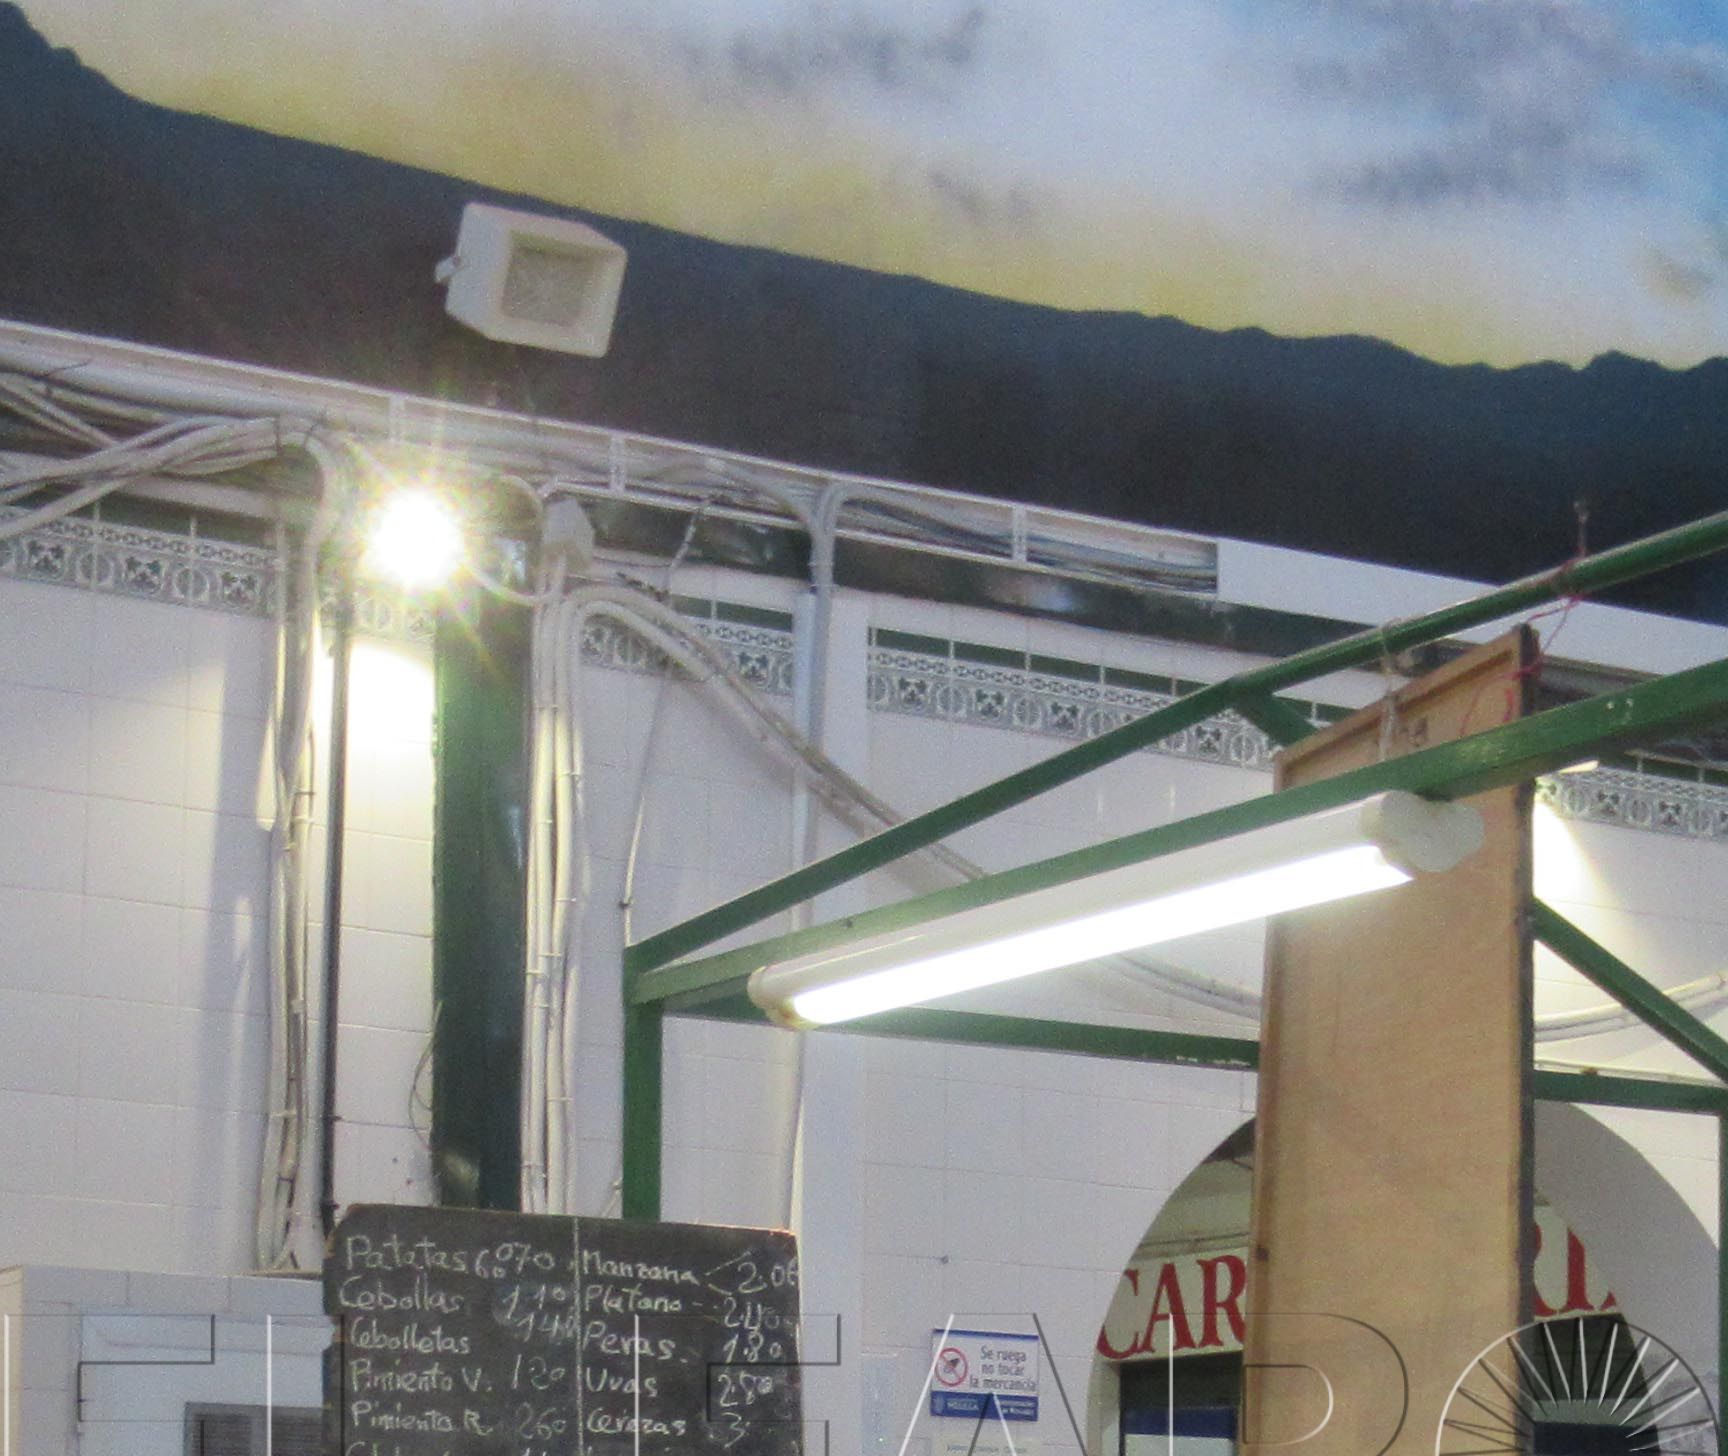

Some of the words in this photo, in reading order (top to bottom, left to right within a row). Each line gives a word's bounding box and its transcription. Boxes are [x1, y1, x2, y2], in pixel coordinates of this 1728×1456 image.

[347, 1234, 469, 1274] Patatas
[583, 1249, 700, 1287] Manzana
[339, 1275, 465, 1314] Cebollas
[350, 1316, 470, 1355] Cebolletas
[350, 1357, 455, 1394] Pimiento
[585, 1366, 658, 1398] Uvas
